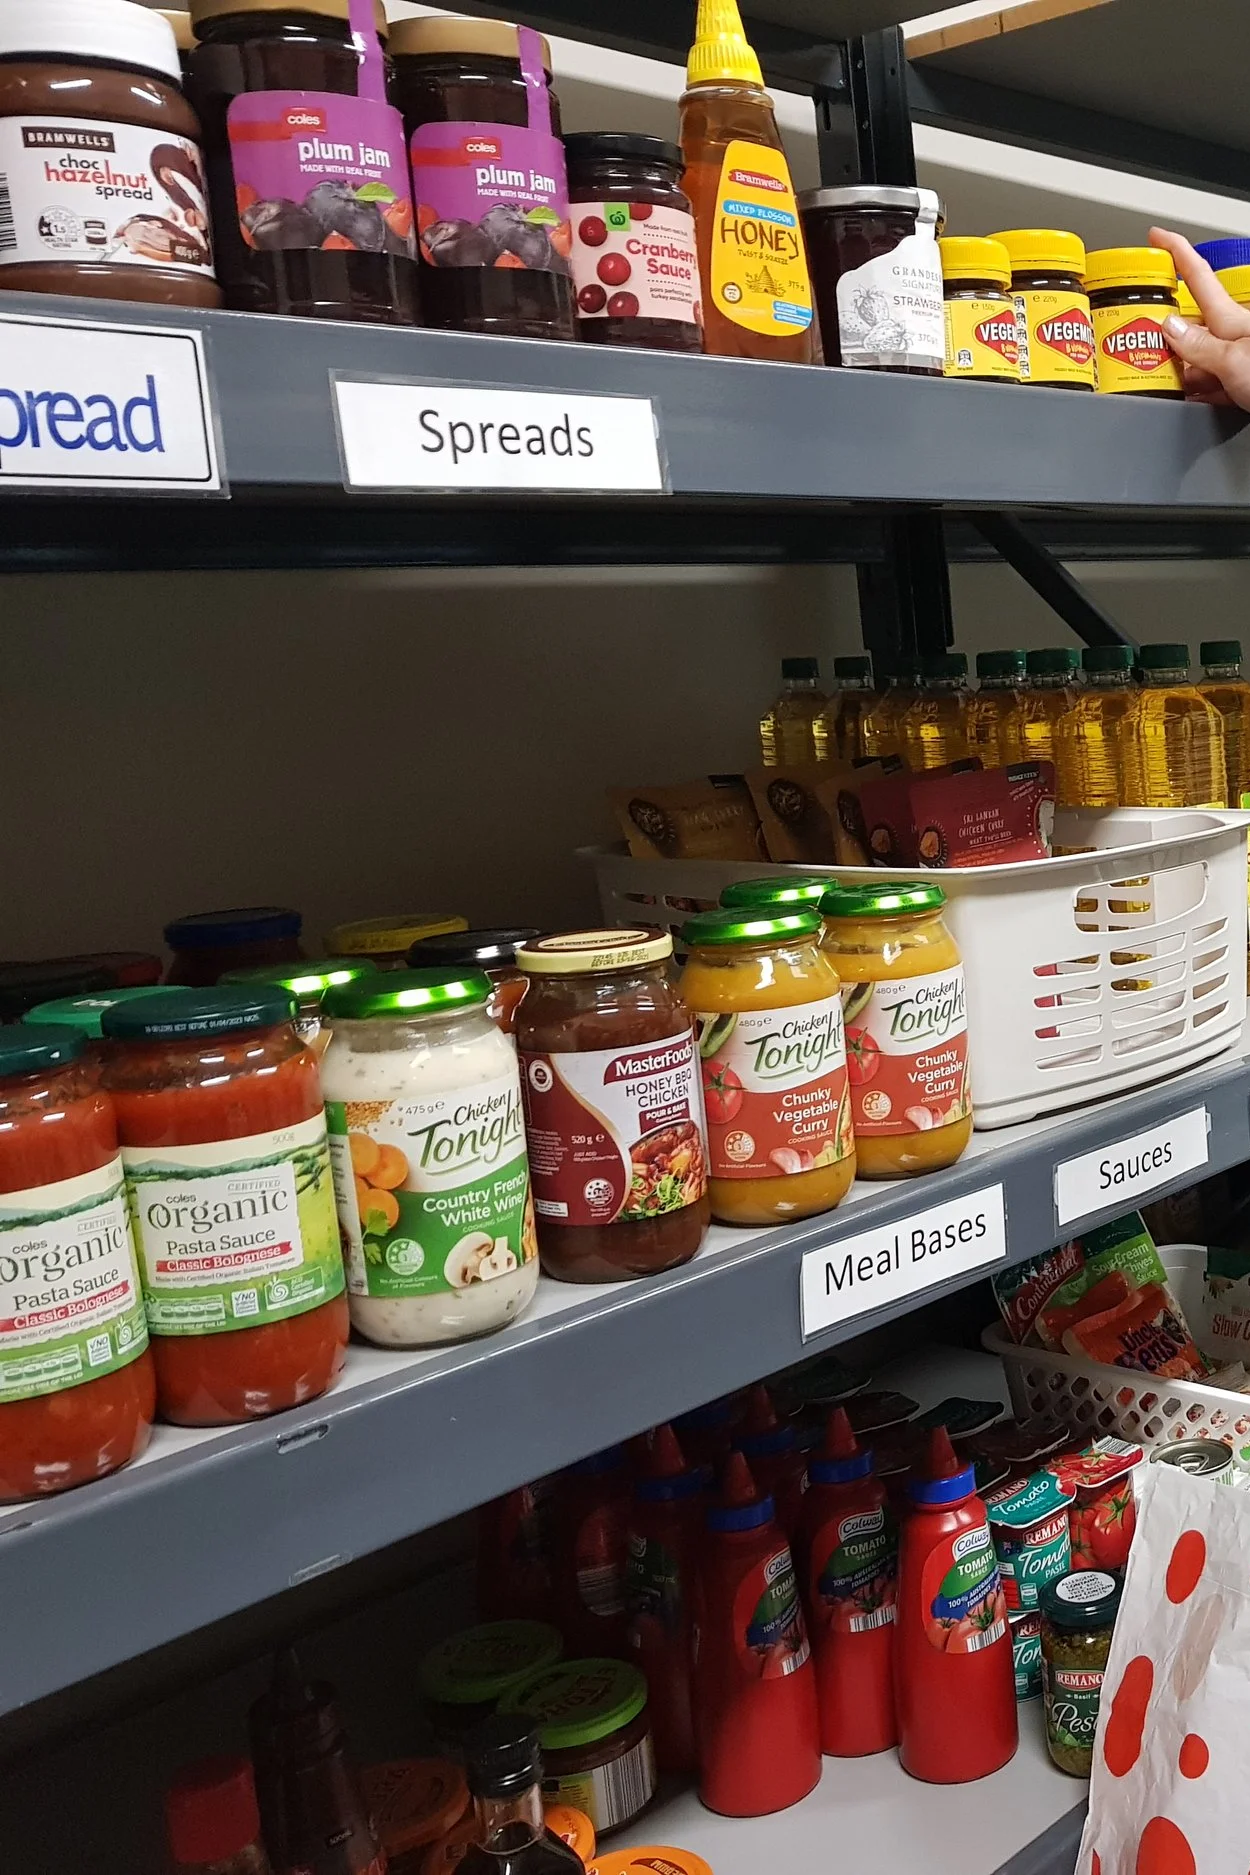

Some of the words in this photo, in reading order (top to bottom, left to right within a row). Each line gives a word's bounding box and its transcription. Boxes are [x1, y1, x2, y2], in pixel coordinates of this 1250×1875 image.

[287, 114, 320, 126] coles
[27, 131, 110, 147] BRAMWELLS
[466, 142, 497, 153] coles
[59, 154, 100, 171] choc
[298, 138, 354, 161] plum
[358, 142, 391, 168] jam
[44, 159, 148, 189] hazelnut
[476, 165, 525, 187] plum
[528, 169, 557, 194] jam
[95, 185, 154, 201] spread
[728, 203, 756, 215] MIXED
[721, 217, 799, 260] HONEY
[647, 258, 692, 280] Sauce
[1106, 331, 1168, 354] VEGEMI
[420, 408, 594, 464] Spreads
[876, 986, 892, 995] 480
[915, 980, 956, 1005] Chicken
[881, 976, 966, 1037] Tonight
[738, 1020, 757, 1028] 480
[782, 1013, 829, 1039] Chicken
[744, 1010, 842, 1073] Tonight
[615, 1043, 693, 1078] MasterFoods
[907, 1060, 964, 1083] Vegetable
[915, 1050, 958, 1069] Chunky
[625, 1078, 673, 1098] HONEY
[675, 1068, 693, 1085] BBQ
[924, 1078, 957, 1095] Curry
[637, 1083, 690, 1109] CHICKEN
[781, 1088, 832, 1107] Chunky
[453, 1091, 509, 1127] Chicken
[645, 1108, 666, 1121] POUR
[773, 1099, 839, 1124] Vegetable
[407, 1087, 522, 1168] Tonight
[571, 1135, 586, 1144] 520
[792, 1118, 829, 1136] Curry
[1098, 1138, 1174, 1191] Sauces
[227, 1179, 281, 1192] CERTIFIED
[423, 1187, 491, 1214] Country
[493, 1171, 526, 1197] French
[166, 1194, 197, 1204] coles
[441, 1206, 491, 1228] White
[493, 1192, 523, 1214] Wine
[147, 1190, 288, 1234] Organic
[12, 1240, 48, 1255] coles
[166, 1239, 216, 1256] Pasta
[220, 1228, 276, 1251] Sauce
[823, 1233, 901, 1296] Meal
[910, 1210, 988, 1265] Bases
[167, 1257, 211, 1273] Classic
[213, 1246, 281, 1269] Bolognese
[14, 1287, 70, 1312] Pasta
[73, 1268, 119, 1297] Sauce
[14, 1309, 66, 1329] Classic
[67, 1285, 124, 1316] Bolognese
[1212, 1312, 1243, 1339] Slow
[992, 1480, 1050, 1515] Tomato
[843, 1533, 887, 1557] TOMATO
[957, 1549, 994, 1577] TOMATO
[970, 1565, 989, 1580] SAUCE
[1045, 1561, 1067, 1580] PASTE
[948, 1596, 969, 1609] 100%
[966, 1583, 992, 1608] TOMATOES
[1057, 1673, 1104, 1686] REMANO
